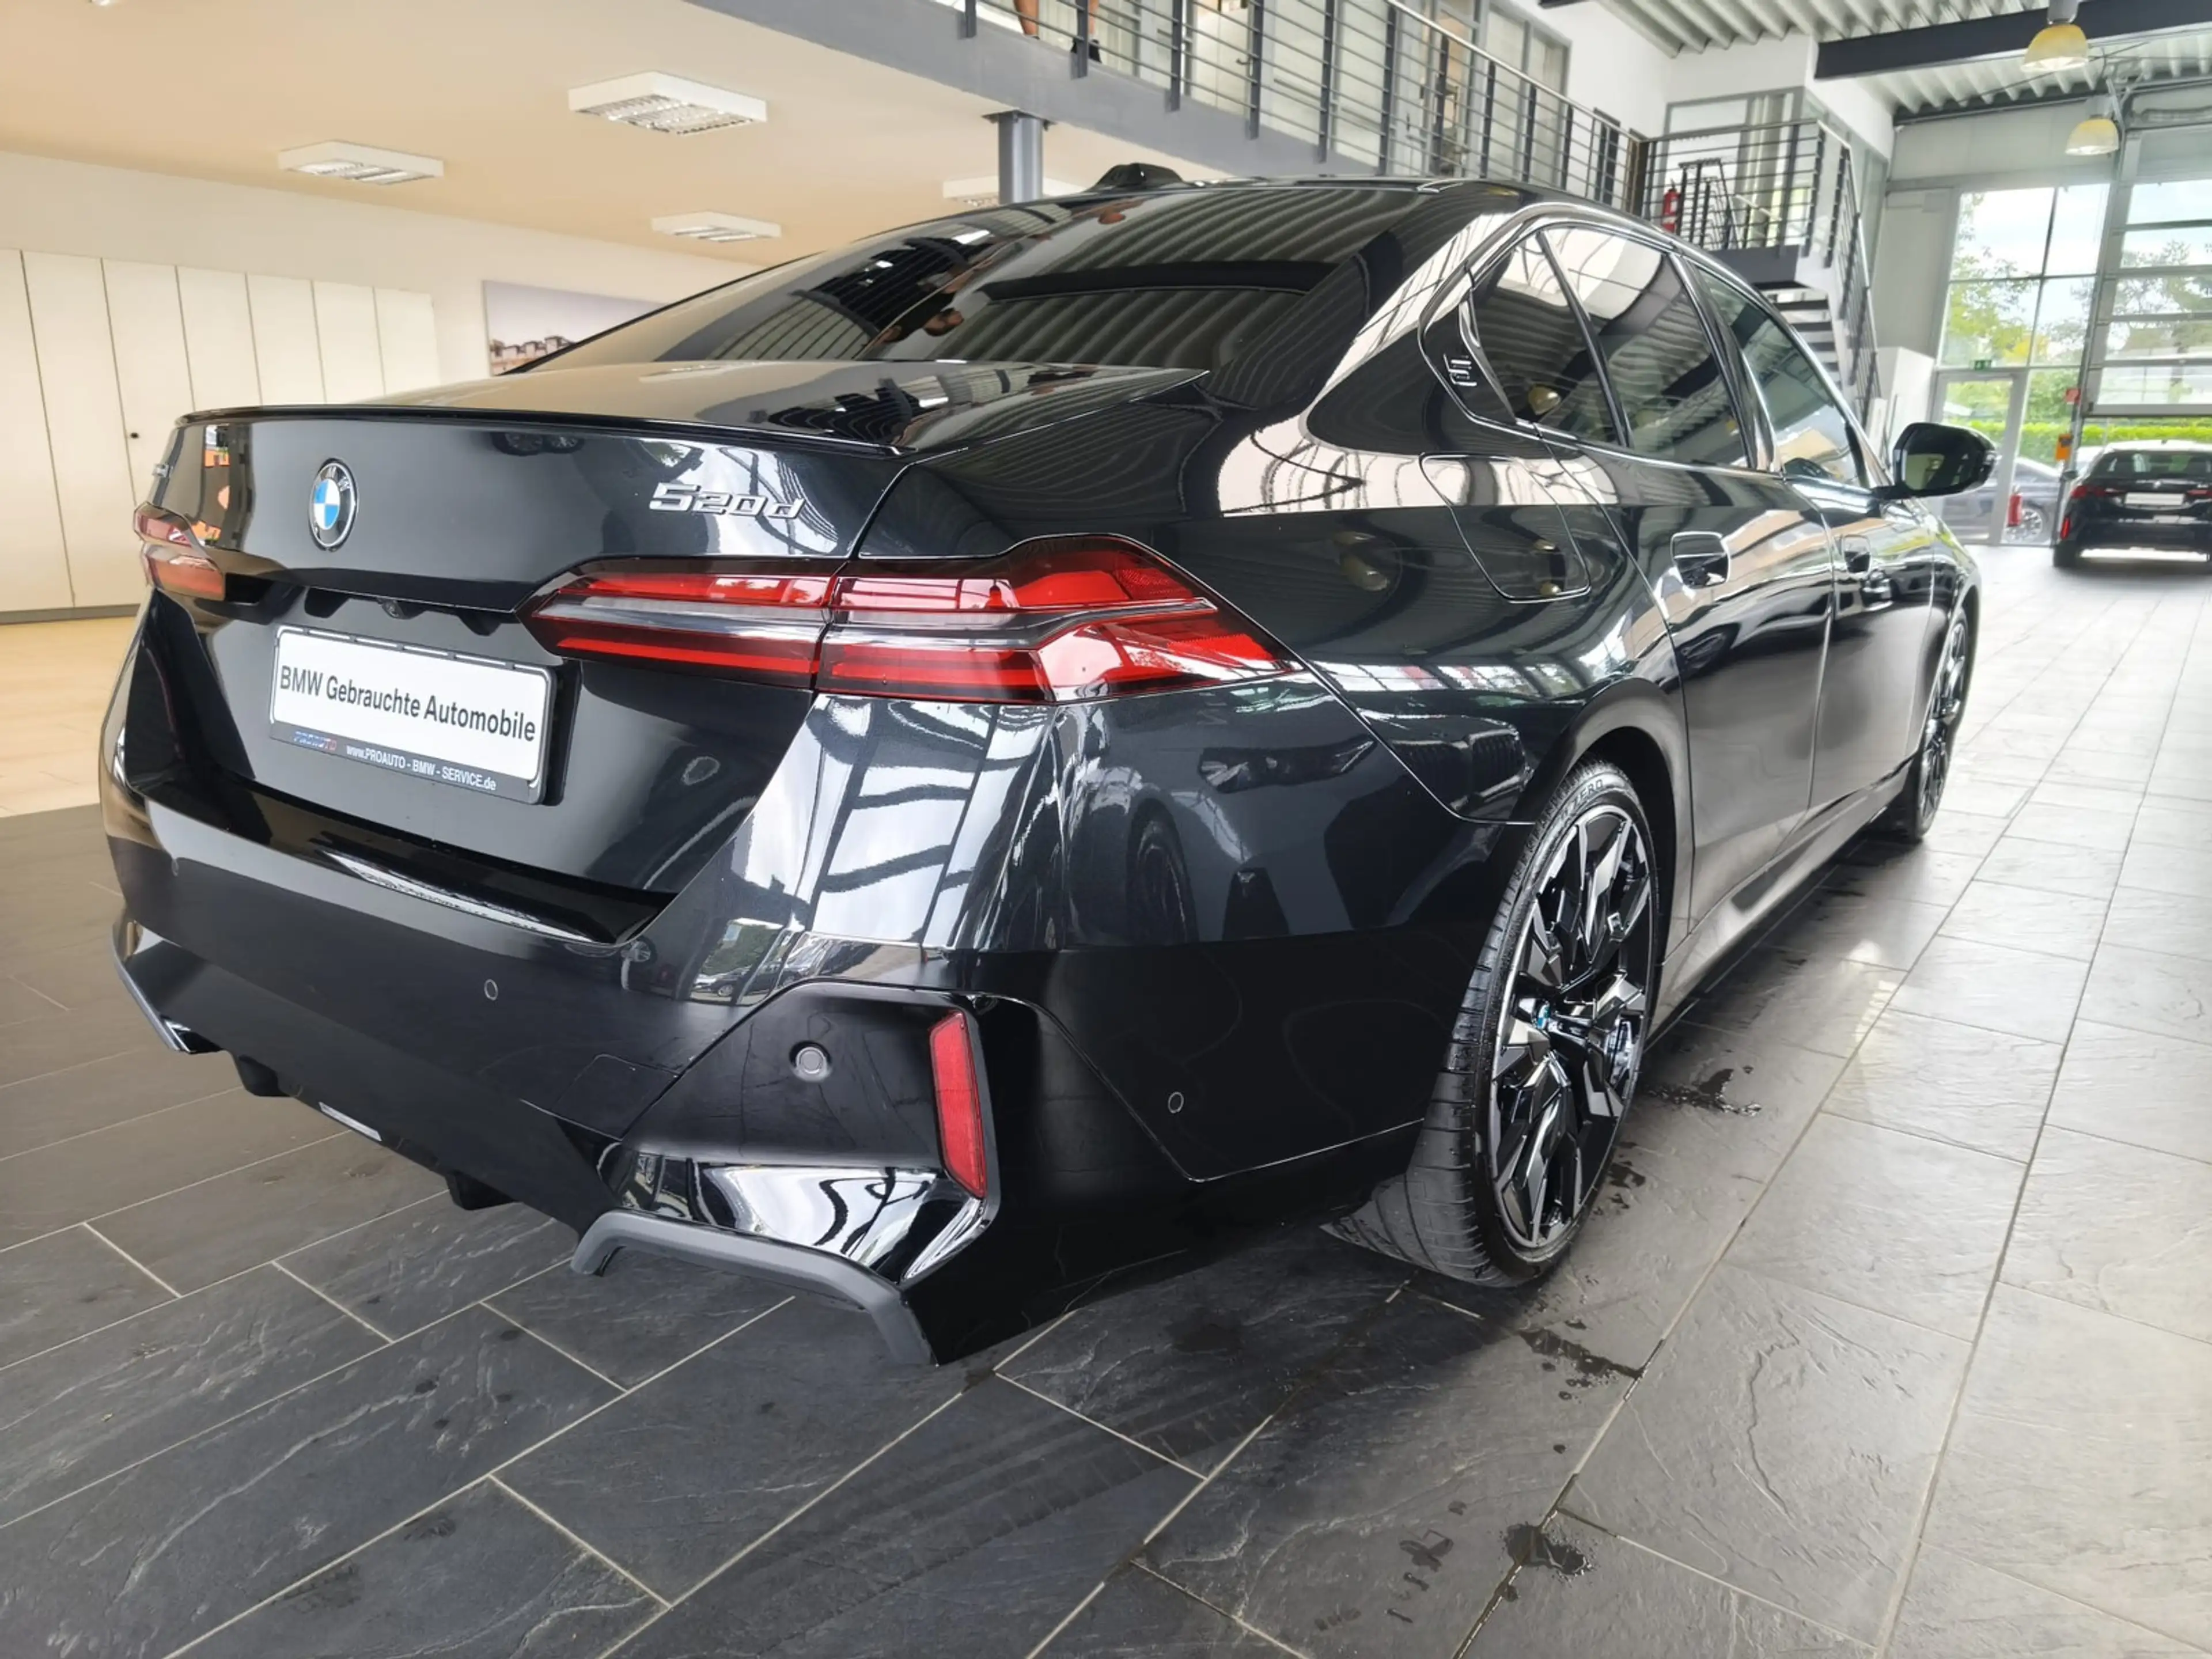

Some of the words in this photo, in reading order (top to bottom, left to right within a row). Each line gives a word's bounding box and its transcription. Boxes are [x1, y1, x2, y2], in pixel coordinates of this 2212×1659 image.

[649, 482, 806, 518] 520d
[280, 666, 323, 696] BMW
[327, 676, 421, 717] Gebrauchte
[424, 695, 535, 741] Automobile
[412, 759, 436, 776] BMW
[442, 766, 497, 790] SERVICE.de
